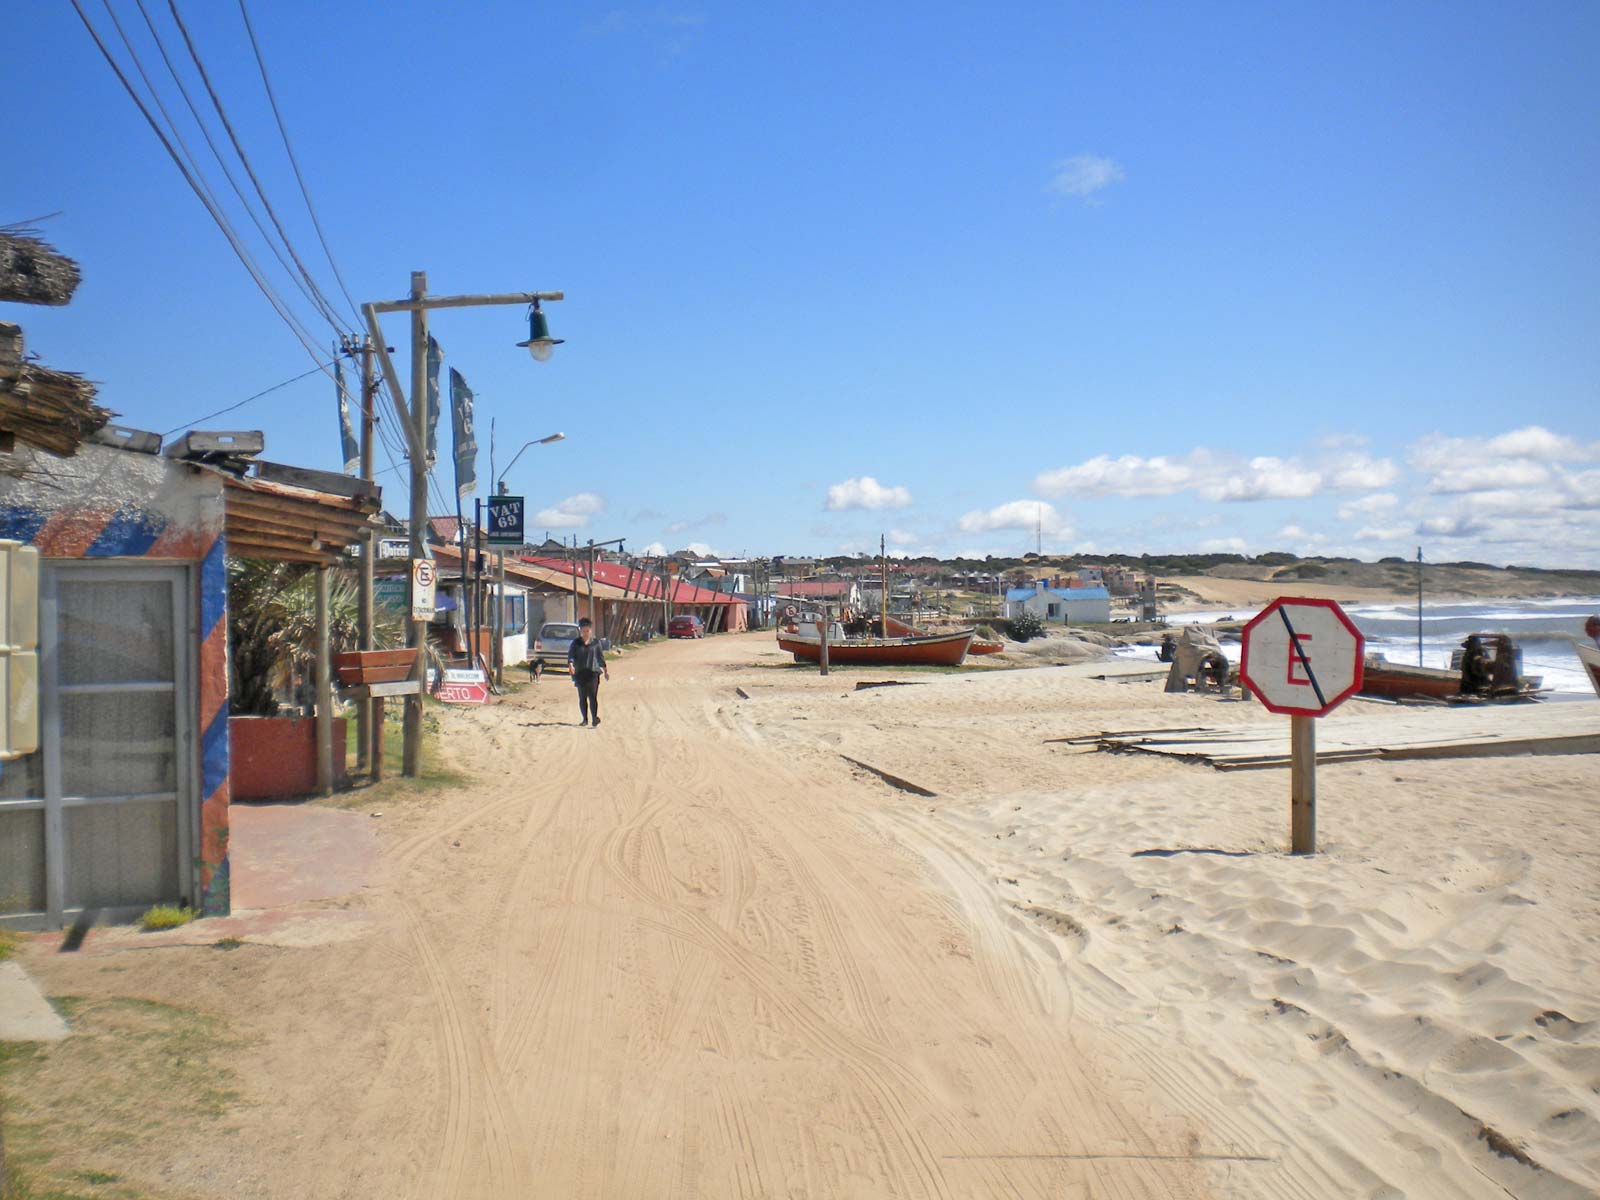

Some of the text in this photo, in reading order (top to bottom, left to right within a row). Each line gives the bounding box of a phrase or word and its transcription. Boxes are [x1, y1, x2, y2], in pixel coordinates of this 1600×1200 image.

[489, 502, 521, 518] VAT
[497, 514, 517, 528] 69
[420, 567, 430, 581] E
[1287, 633, 1313, 686] E
